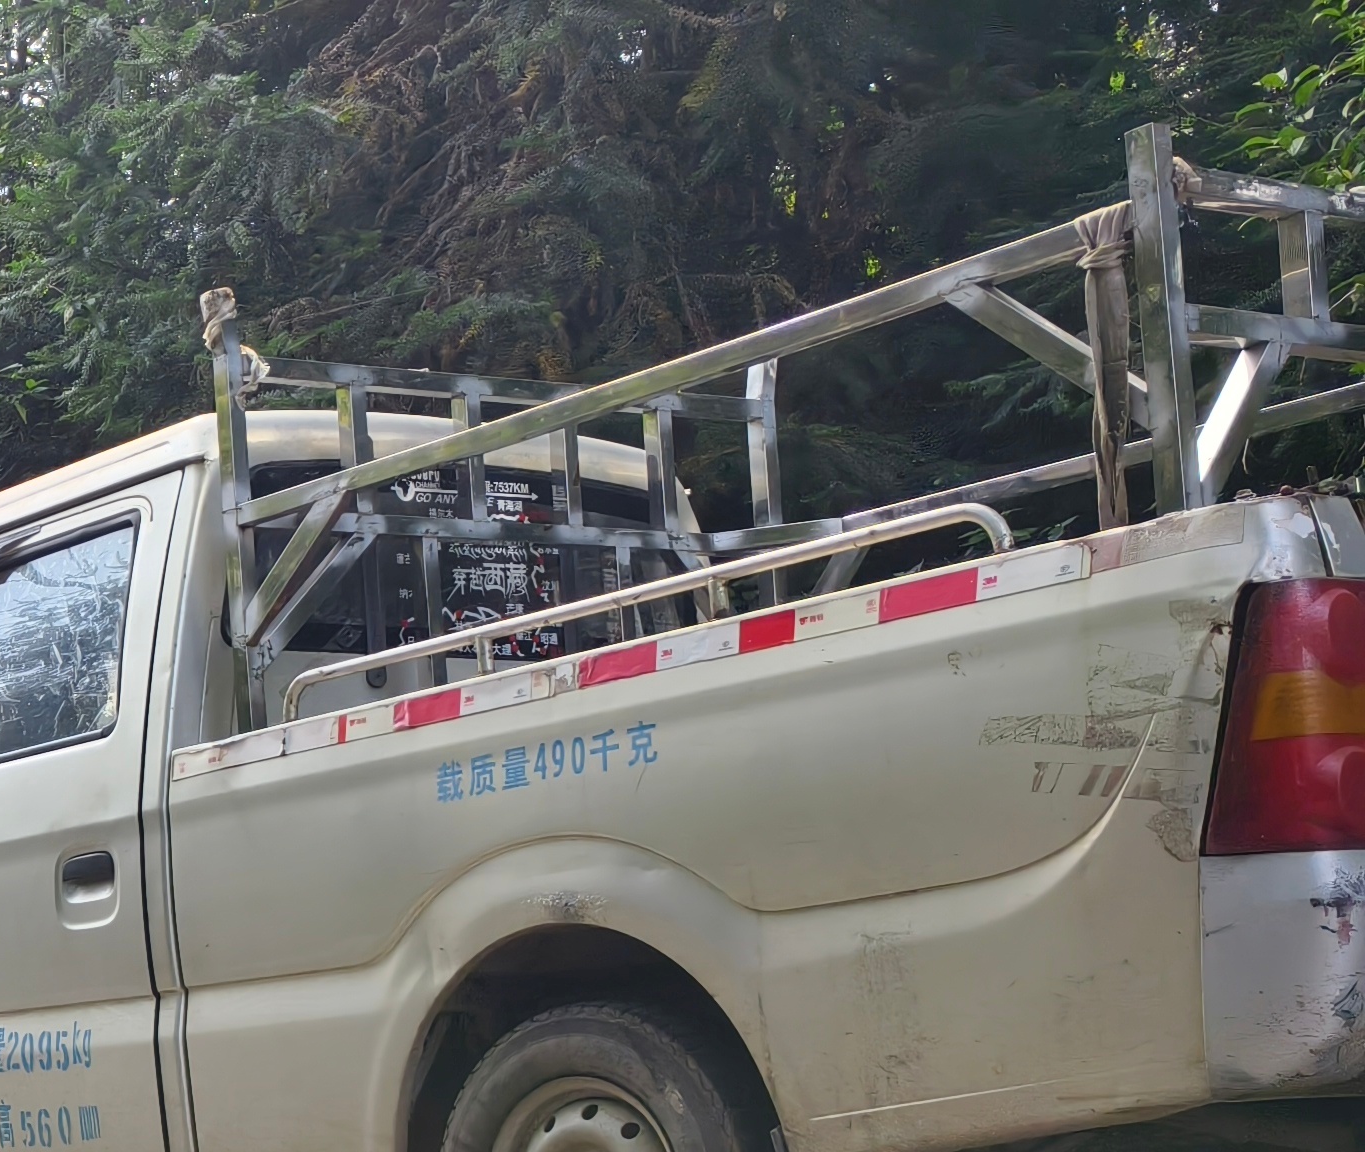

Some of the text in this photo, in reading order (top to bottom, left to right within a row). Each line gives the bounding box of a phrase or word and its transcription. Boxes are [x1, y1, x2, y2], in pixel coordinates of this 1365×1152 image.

[415, 492, 432, 503] GO
[447, 562, 531, 603] 穿越西藏
[436, 720, 658, 803] 载质量490千克
